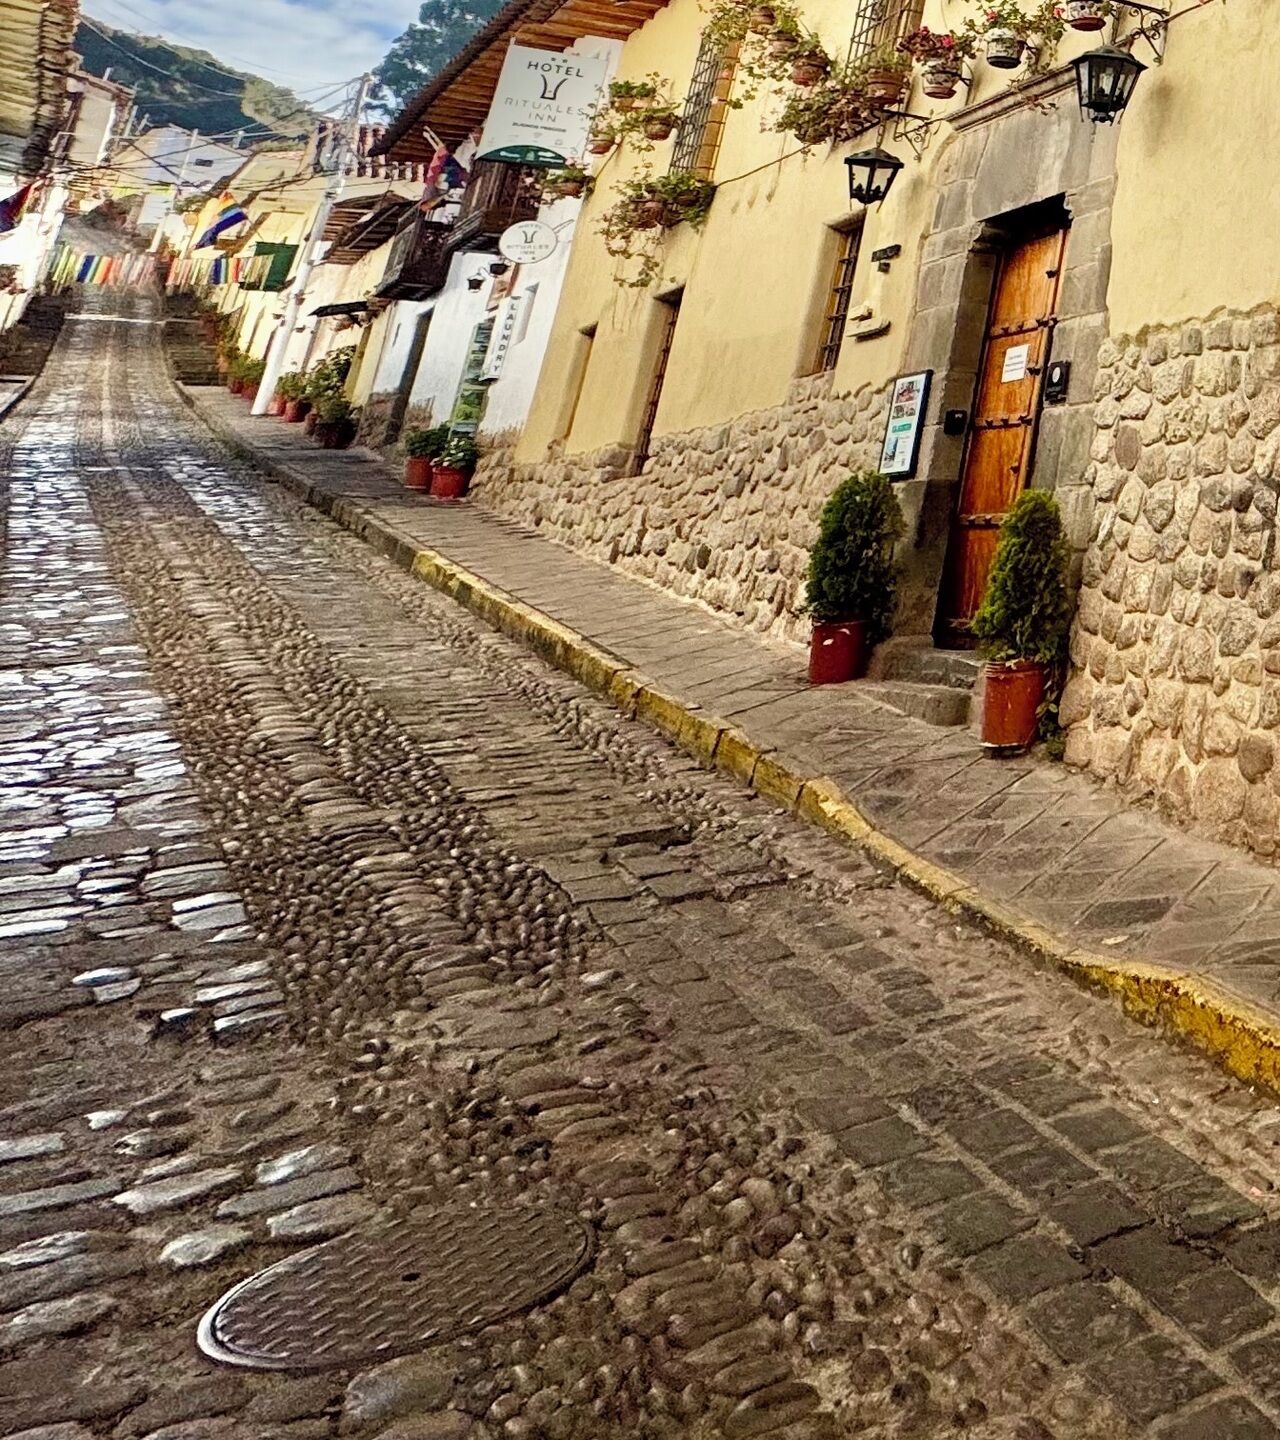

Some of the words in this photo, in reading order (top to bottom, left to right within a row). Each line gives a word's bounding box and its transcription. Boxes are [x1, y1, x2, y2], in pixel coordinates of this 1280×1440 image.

[526, 61, 584, 78] HOTEL
[504, 96, 586, 116] RITUALES
[528, 112, 557, 123] INN
[494, 303, 519, 372] LAUNDRY
